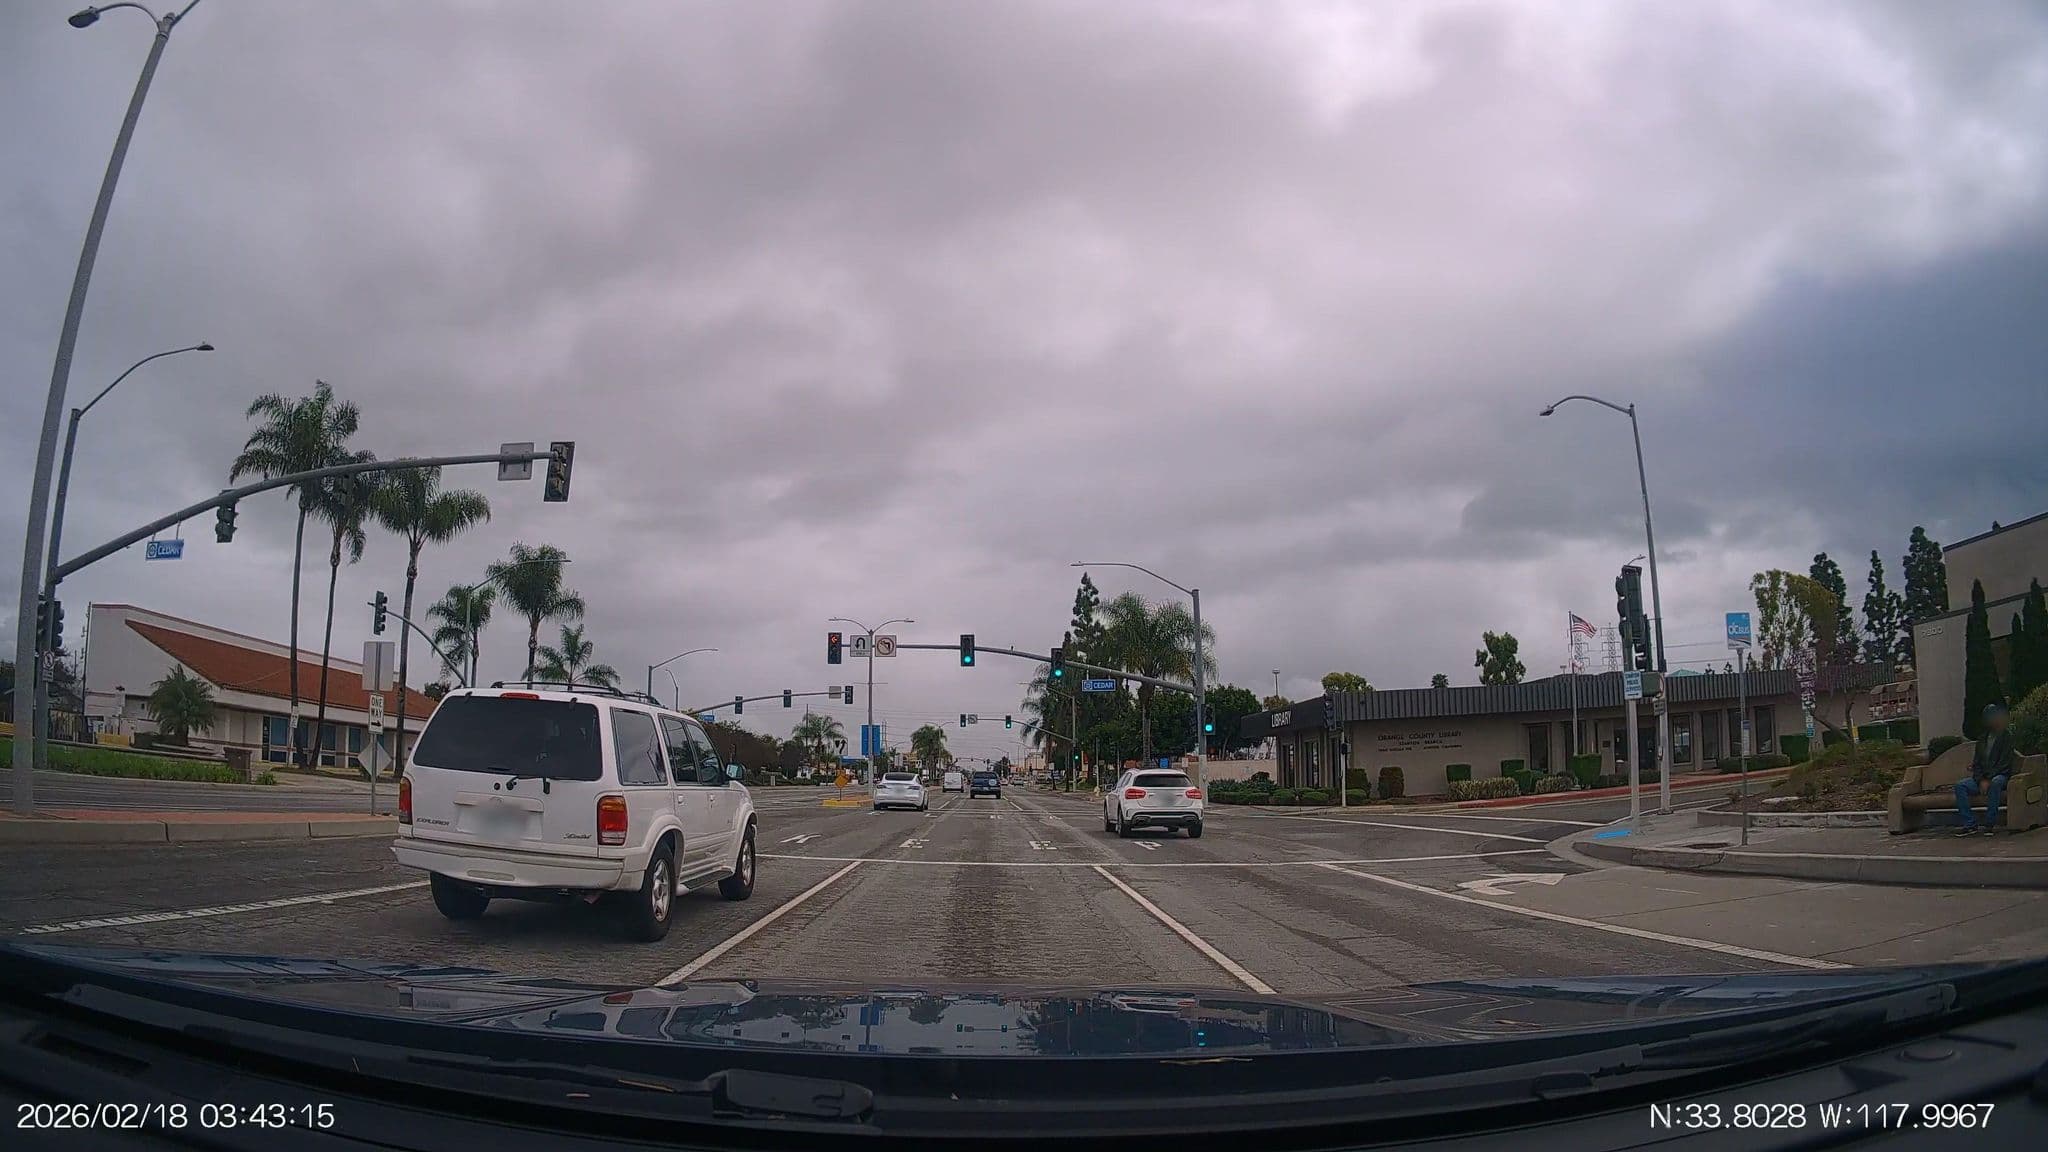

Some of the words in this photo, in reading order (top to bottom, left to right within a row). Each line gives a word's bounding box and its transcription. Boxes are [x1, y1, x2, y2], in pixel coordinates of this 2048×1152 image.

[1093, 681, 1114, 689] CEDAR
[371, 697, 383, 707] ONE
[370, 707, 382, 717] WAY
[1271, 710, 1292, 728] LIBRARY
[1408, 731, 1435, 740] COUNTY
